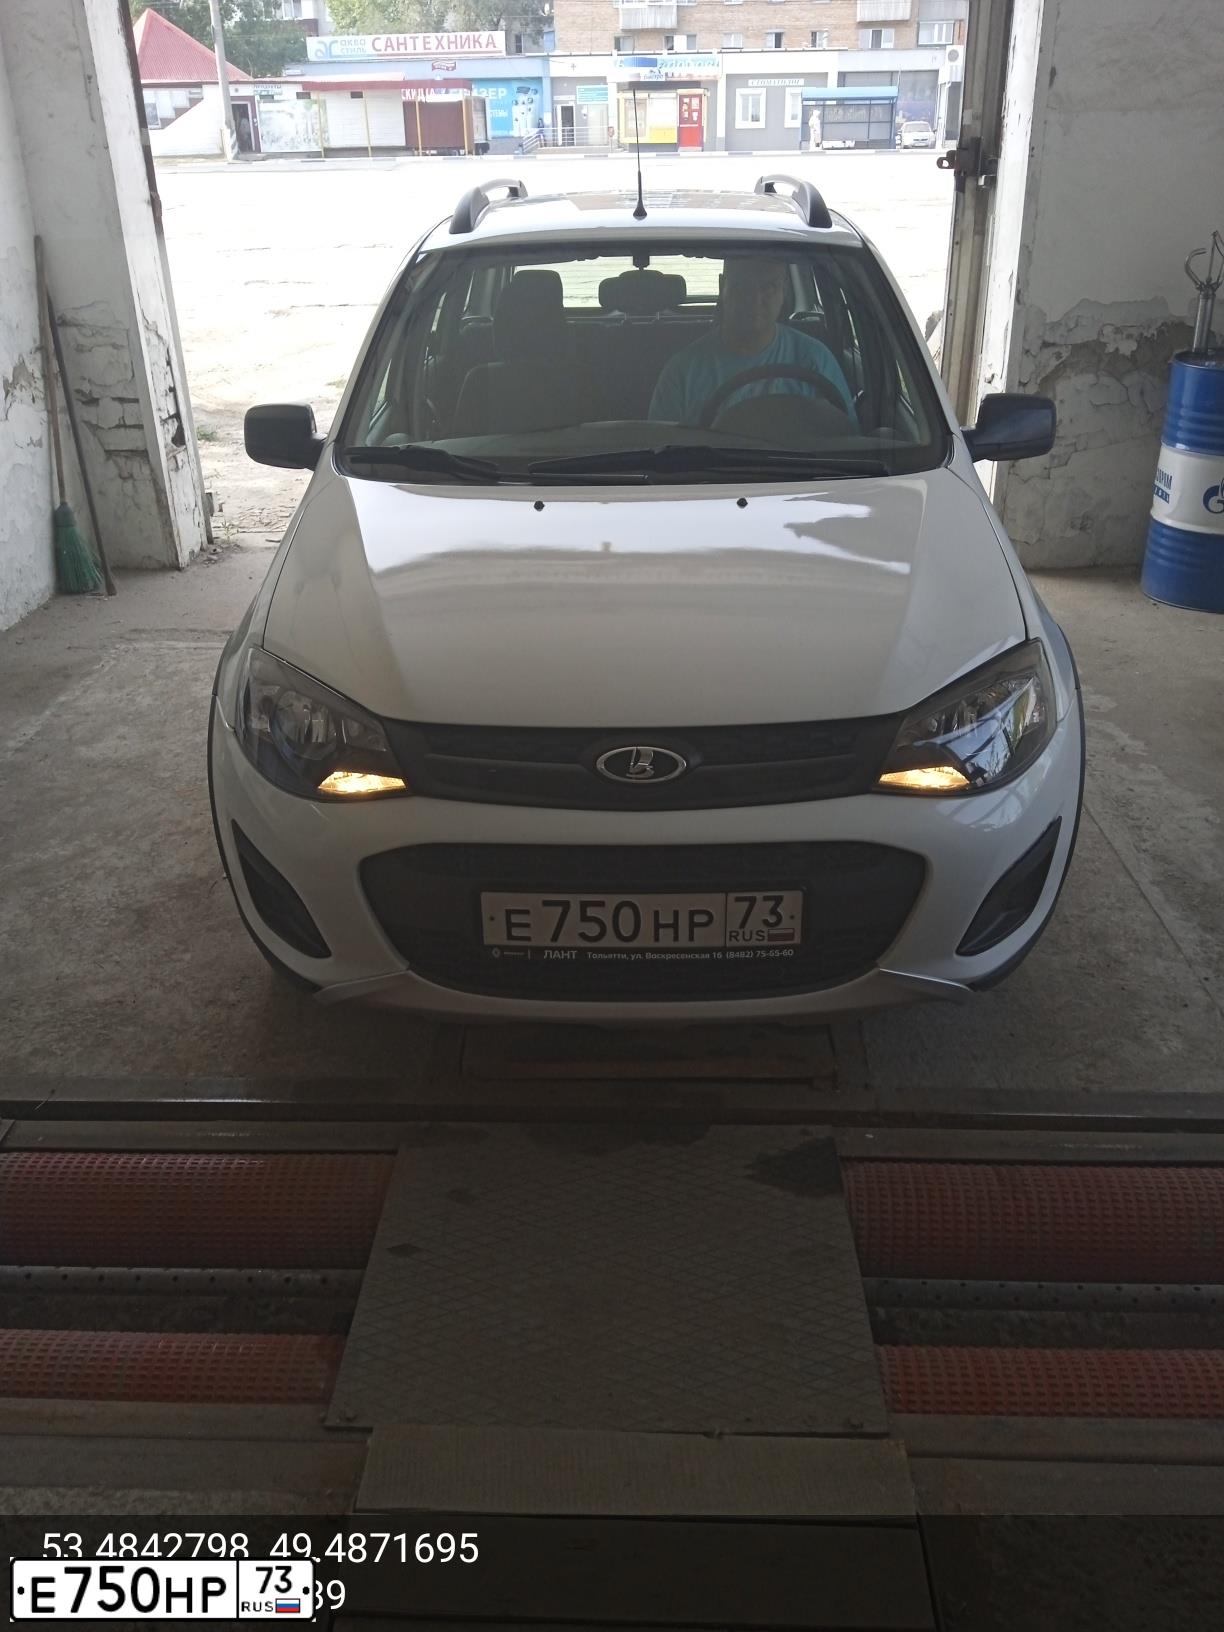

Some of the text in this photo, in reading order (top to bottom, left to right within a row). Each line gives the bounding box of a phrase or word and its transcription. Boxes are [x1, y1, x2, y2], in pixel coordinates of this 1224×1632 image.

[371, 34, 497, 52] САНТЕХНИКА
[504, 900, 714, 942] Е750НР
[734, 895, 784, 929] 73
[729, 928, 766, 943] RUS
[543, 950, 577, 960] ЛАНТ
[587, 951, 628, 961] Тольятти,
[645, 951, 710, 960] Воскресенская
[712, 951, 723, 960] 16
